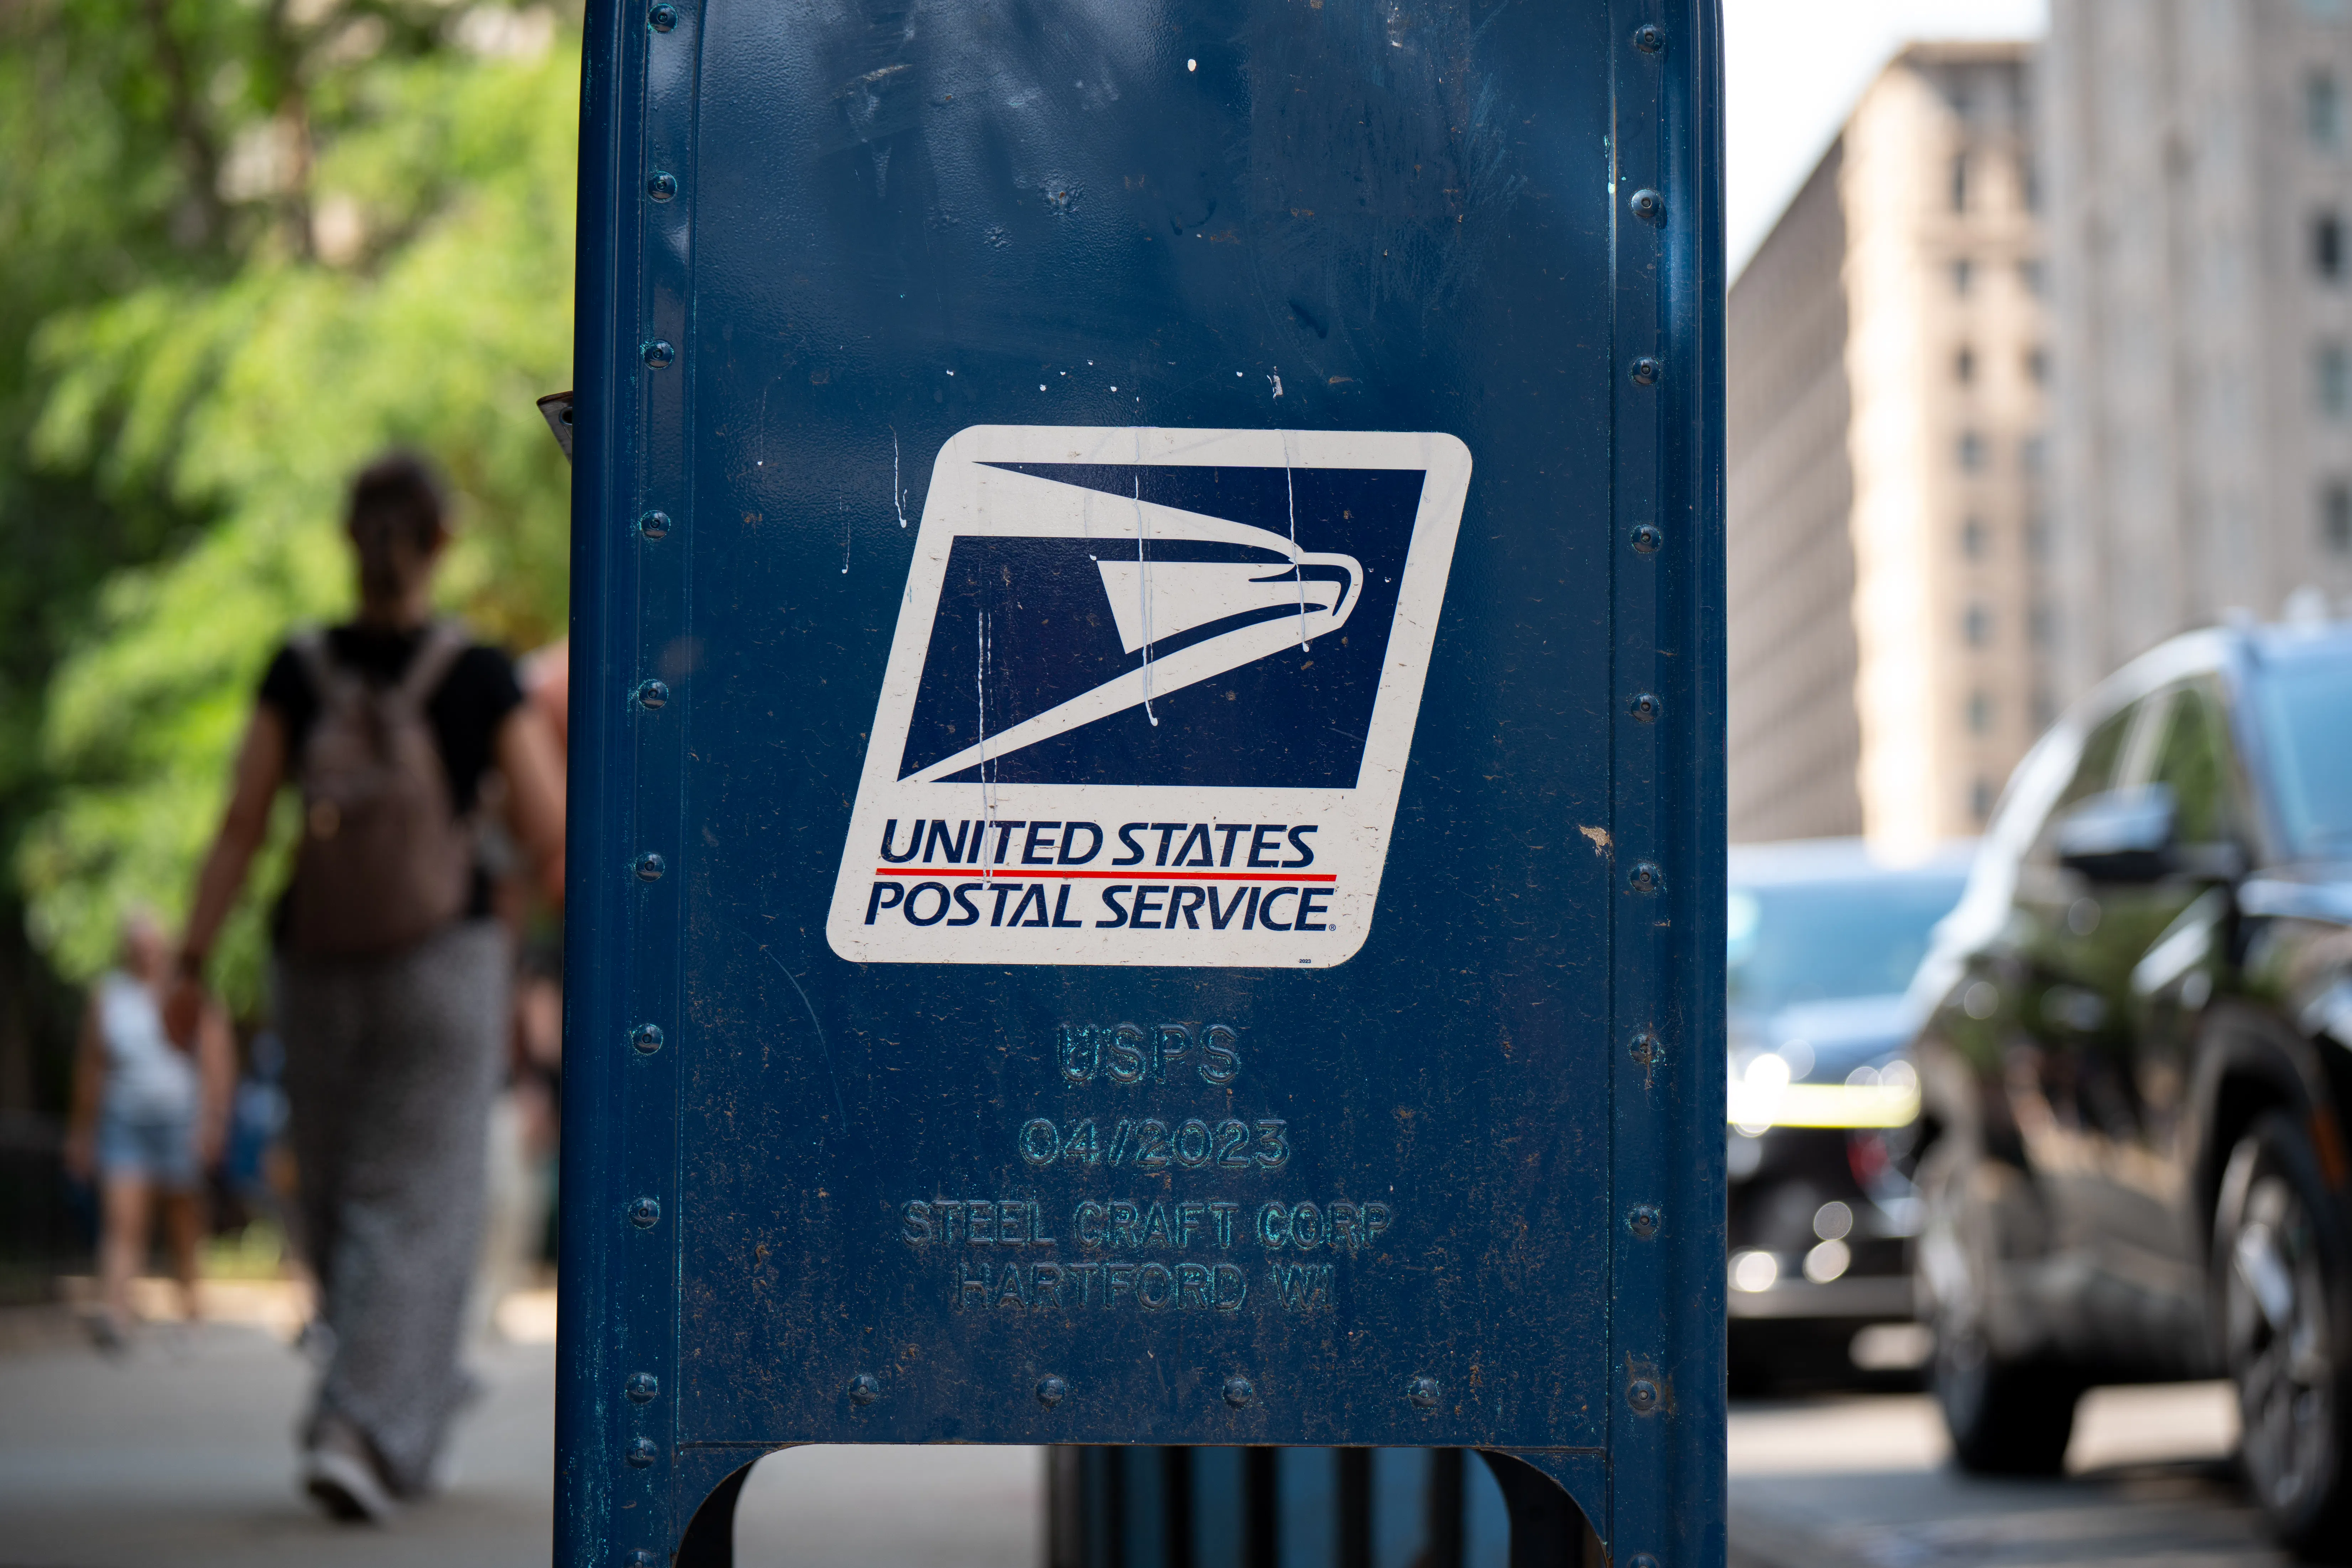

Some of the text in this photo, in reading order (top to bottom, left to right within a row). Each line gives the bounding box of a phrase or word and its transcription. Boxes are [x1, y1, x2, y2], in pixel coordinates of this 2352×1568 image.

[881, 819, 1318, 868] UNITED STATES
[864, 881, 1082, 928] POSTAL
[1058, 1023, 1241, 1084] USPS
[1019, 1118, 1290, 1167] 04/2023
[901, 1199, 1392, 1249] STEEL CRAFT CORP
[956, 1262, 1335, 1311] HARTFORD WI
